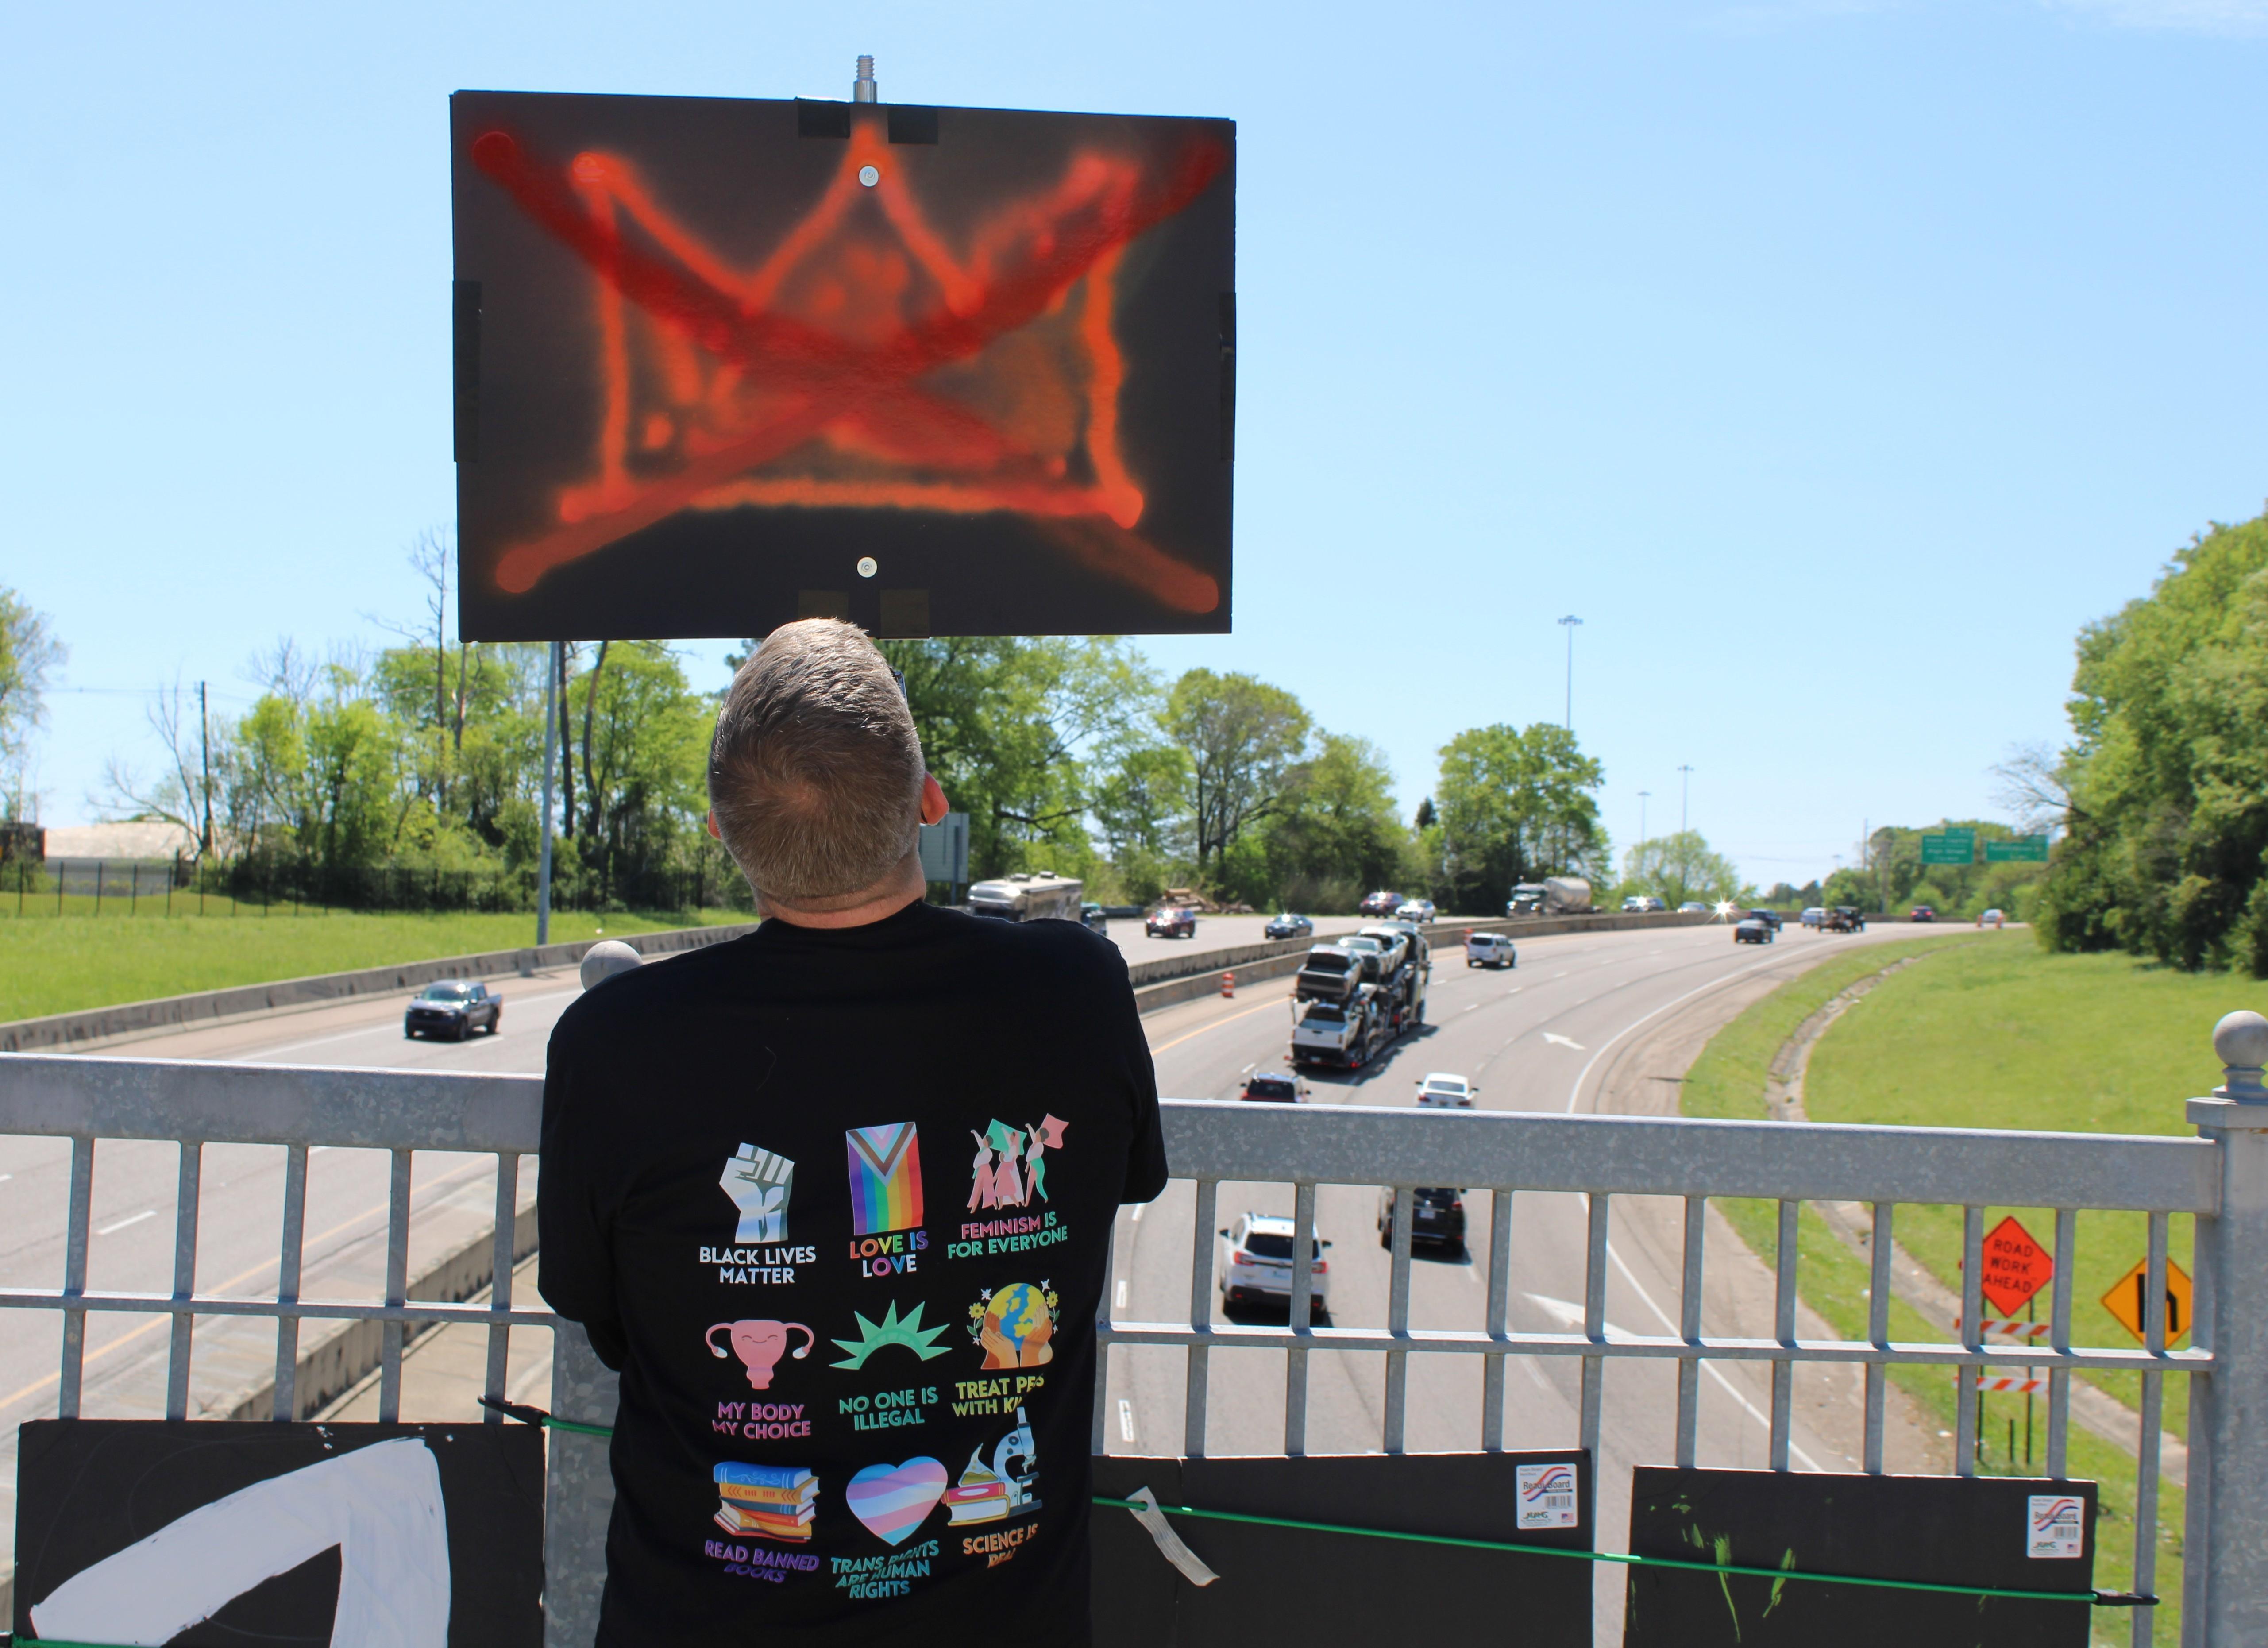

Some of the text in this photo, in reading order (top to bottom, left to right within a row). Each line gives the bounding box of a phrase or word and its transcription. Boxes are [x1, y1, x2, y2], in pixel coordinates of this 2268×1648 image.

[961, 1211, 1057, 1239] FEMINISM IS
[850, 1231, 929, 1259] LOVE IS
[947, 1225, 1068, 1259] FOR EVERYONE
[1994, 1239, 2033, 1258] ROAD
[699, 1246, 816, 1265] BLACK LIVES
[862, 1254, 917, 1277] LOVE
[1990, 1257, 2032, 1274] WORK
[719, 1266, 795, 1284] MATTER
[1984, 1273, 2032, 1293] AHEAD
[955, 1375, 1045, 1400] TREAT PEO
[839, 1386, 939, 1414] NO ONE IS
[952, 1398, 998, 1417] WITH
[718, 1401, 805, 1421] MY BODY
[853, 1408, 925, 1431] ILLEGAL
[712, 1419, 811, 1439] MY CHOICE
[963, 1523, 1038, 1555] SCIENCE IS
[705, 1540, 820, 1571] READ BANNED
[830, 1556, 885, 1574] TRANS
[724, 1563, 787, 1583] BOOKS
[835, 1559, 930, 1588] ARE HUMAN
[849, 1580, 910, 1599] RIGHTS
